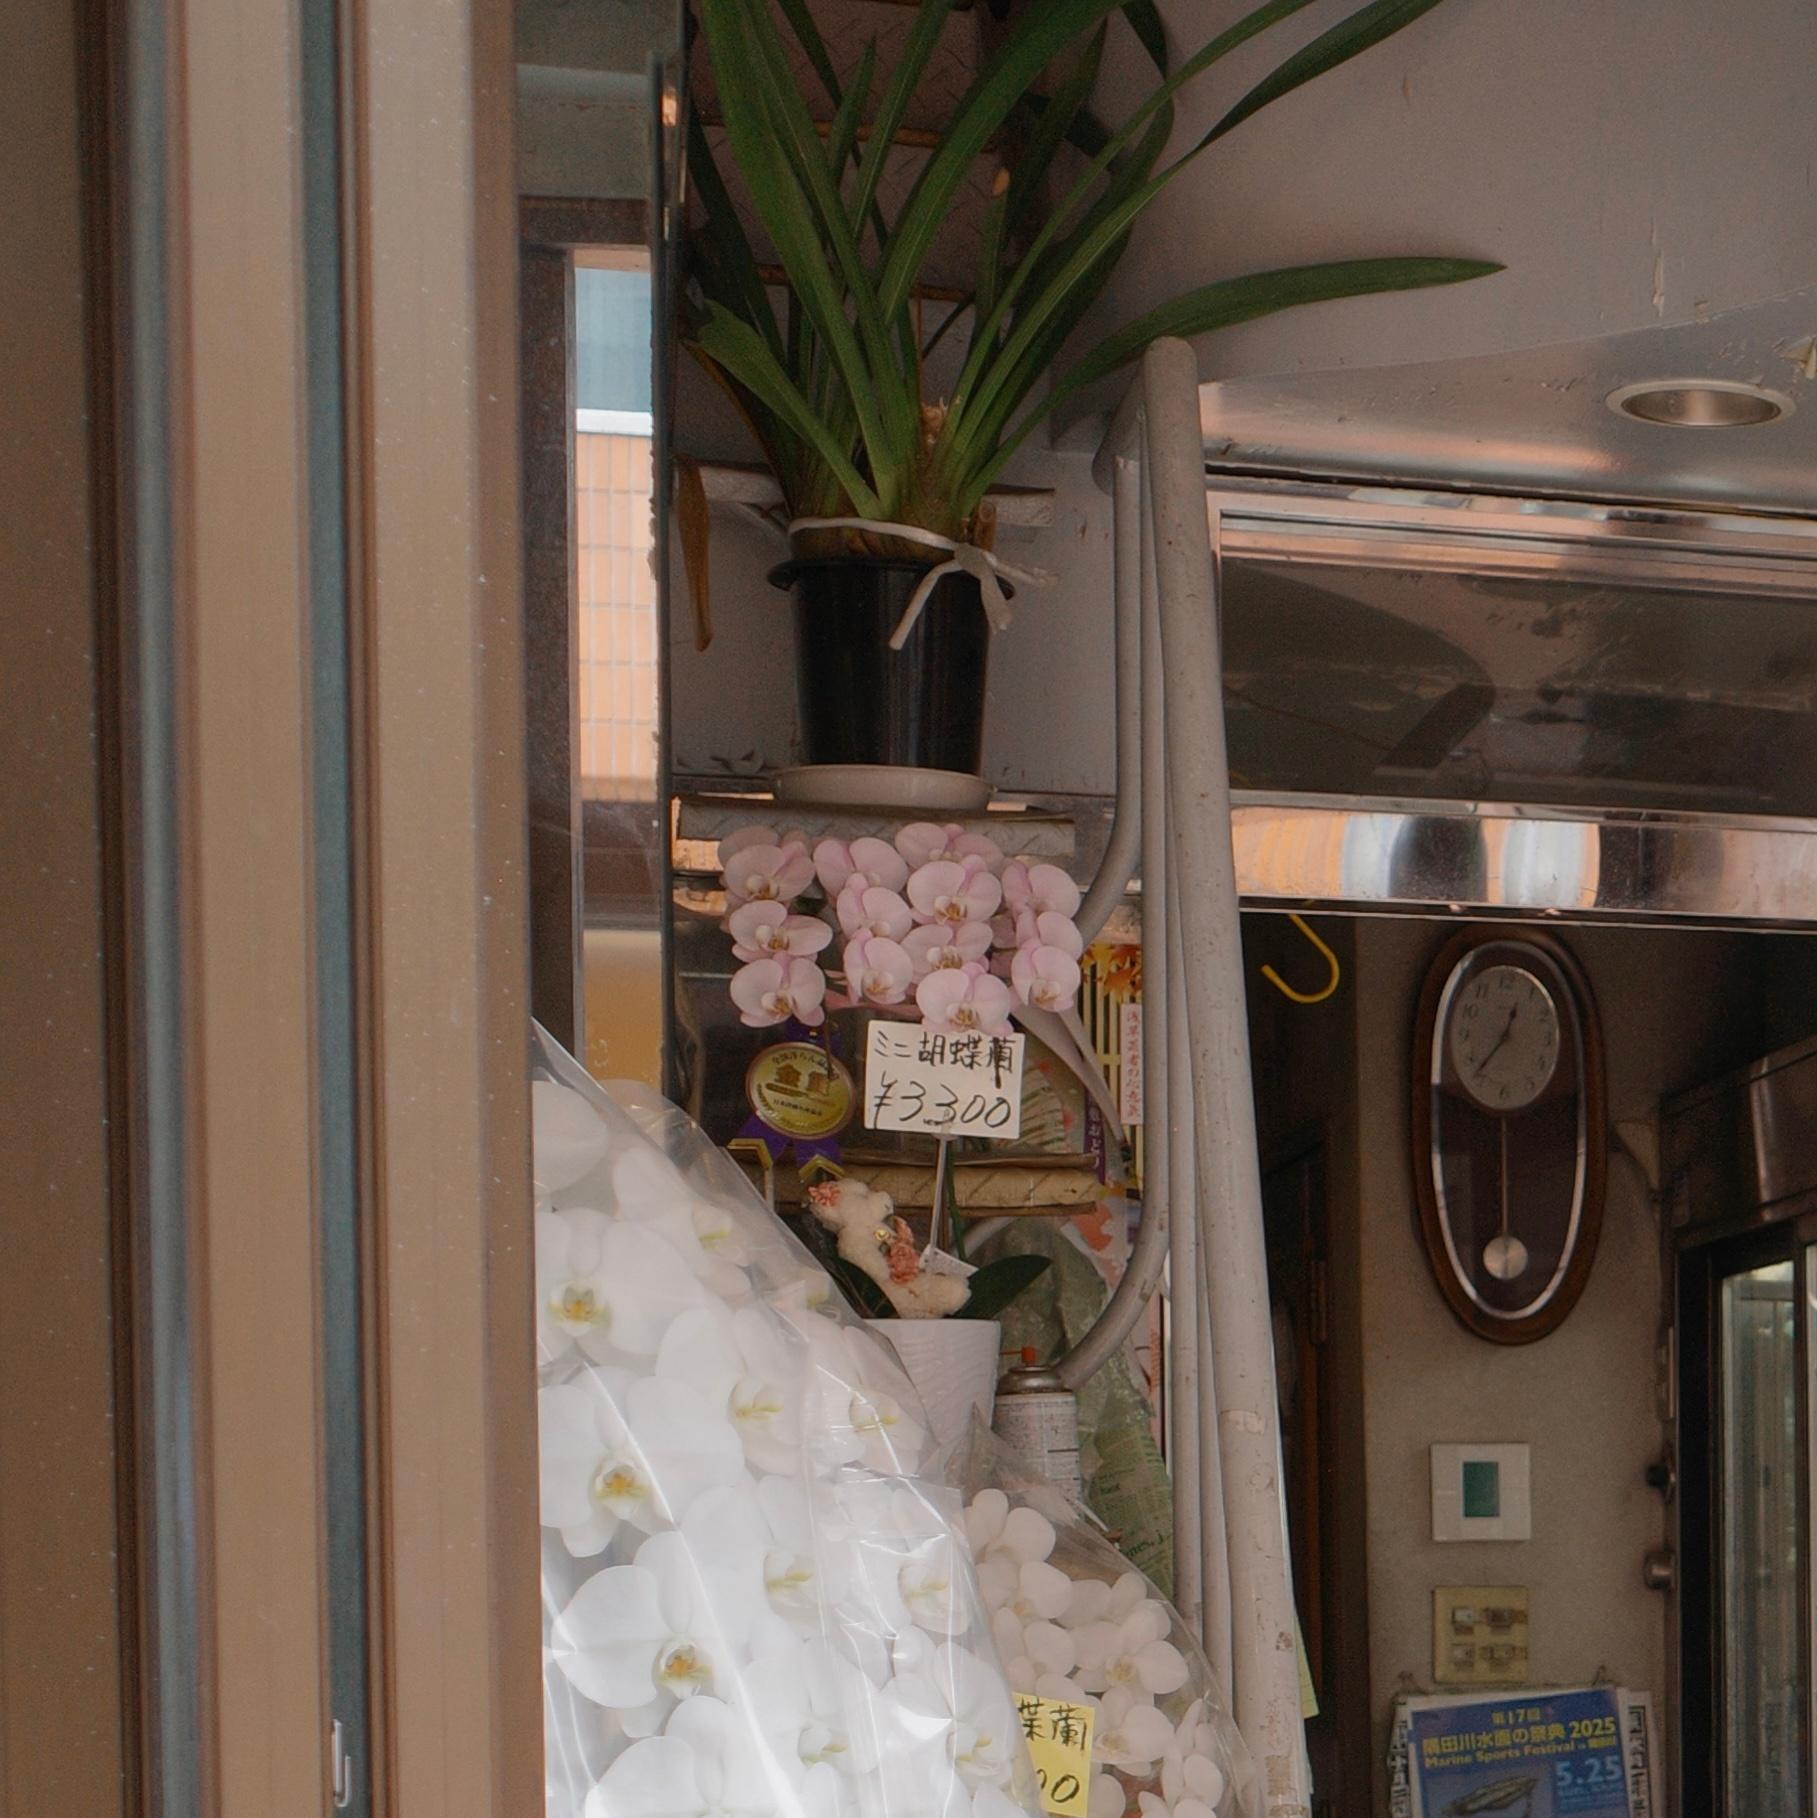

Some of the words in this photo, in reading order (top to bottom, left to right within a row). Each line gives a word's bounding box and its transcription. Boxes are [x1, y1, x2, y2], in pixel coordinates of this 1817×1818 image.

[1570, 1717, 1616, 1737] 2025
[1425, 1753, 1472, 1768] Marine
[1476, 1749, 1521, 1765] Sports
[1524, 1743, 1574, 1757] Festival
[1556, 1755, 1621, 1786] 5.25
